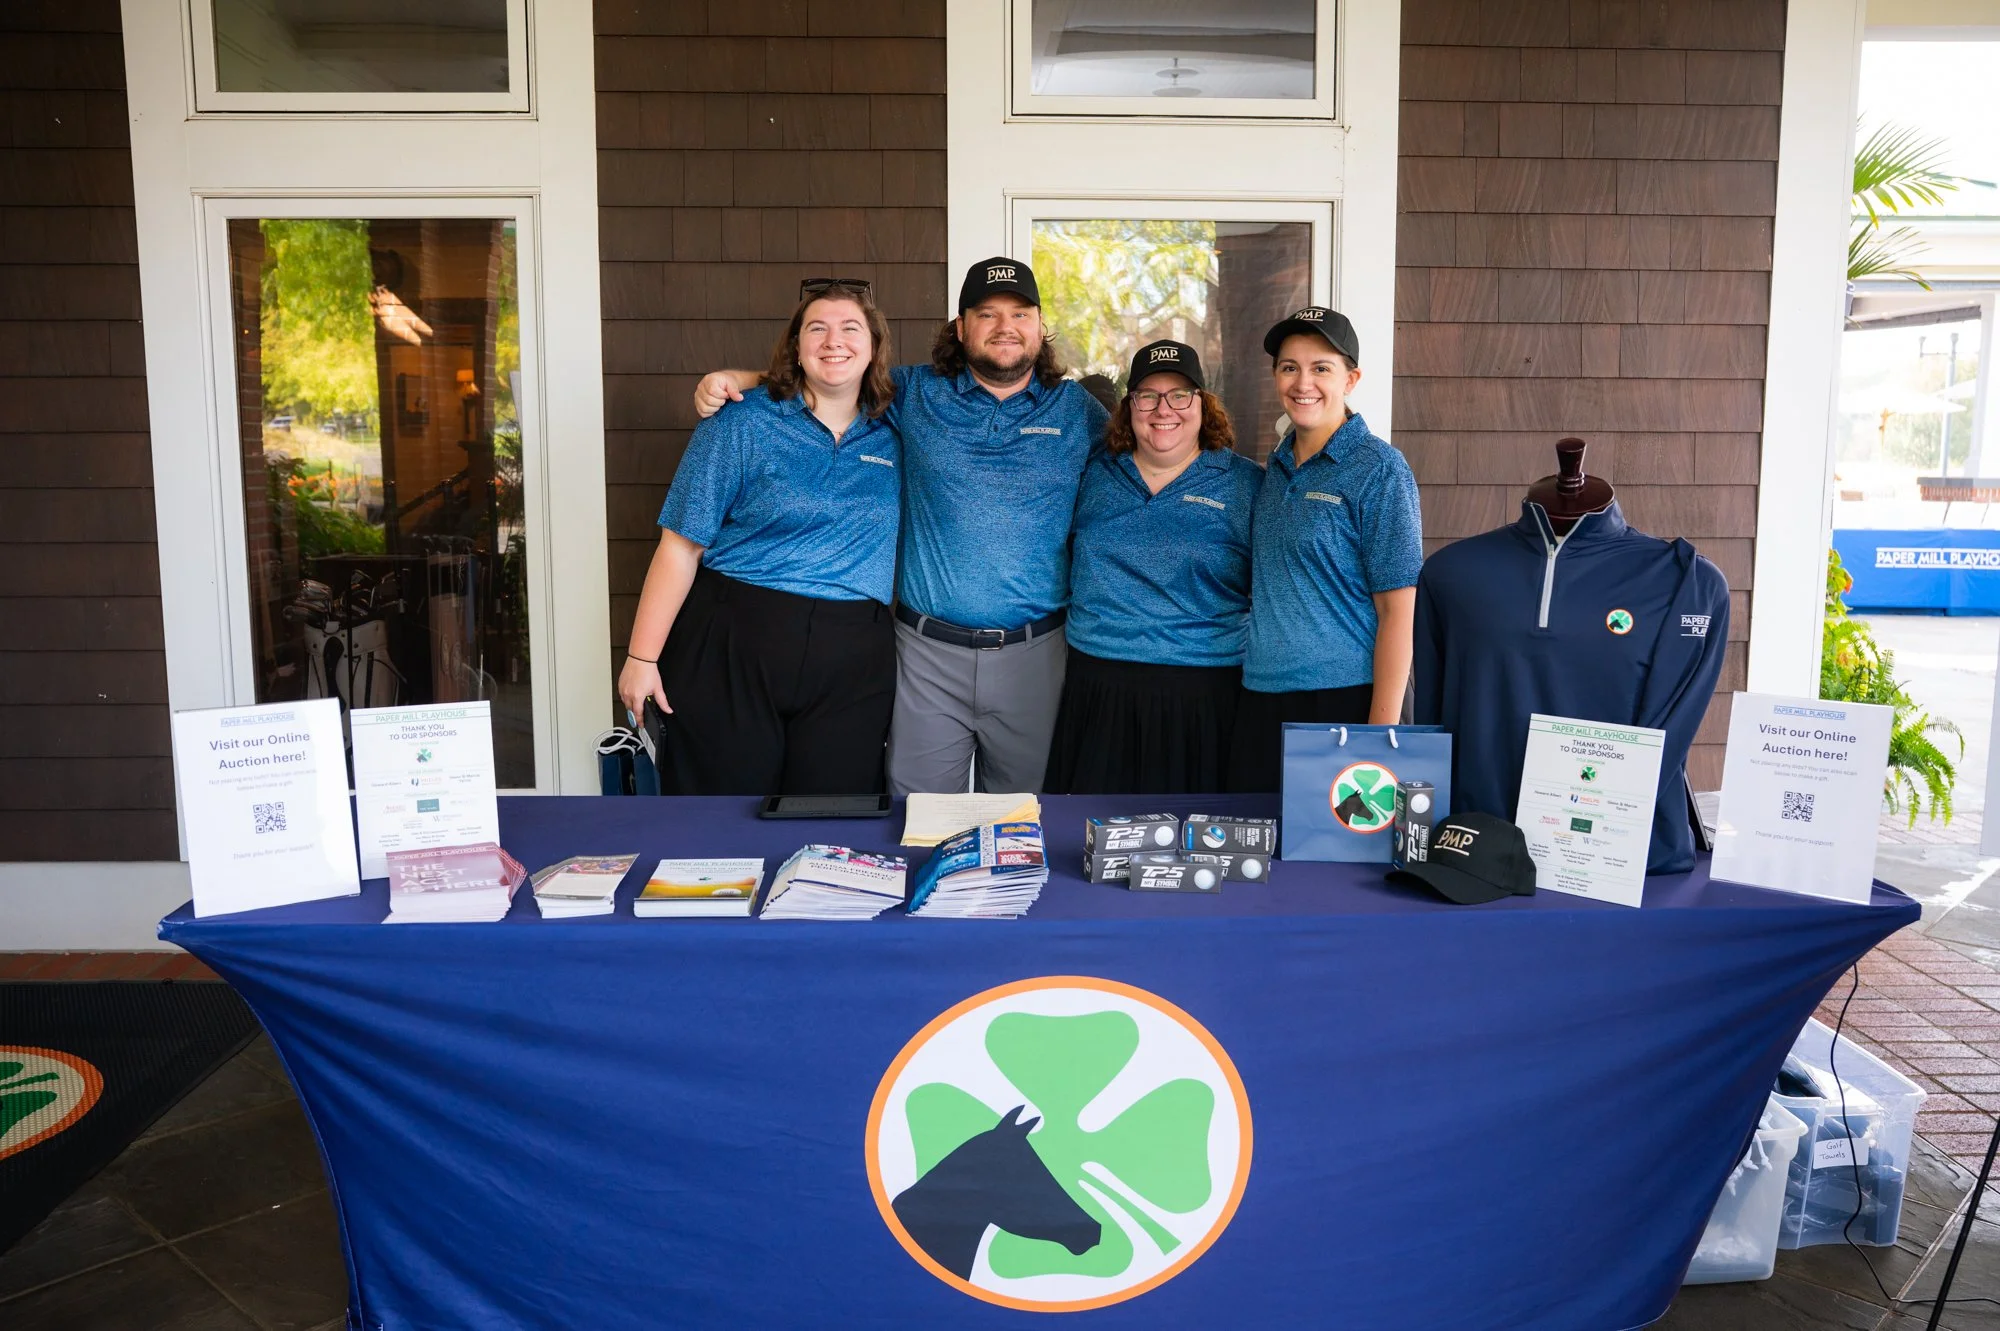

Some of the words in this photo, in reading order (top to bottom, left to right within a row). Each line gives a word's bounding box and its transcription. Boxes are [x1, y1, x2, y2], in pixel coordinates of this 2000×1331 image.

[987, 268, 1016, 281] PMP
[1295, 310, 1324, 319] PMP
[1150, 348, 1178, 360] PMP
[1876, 551, 1916, 564] PAPER
[1917, 551, 1948, 566] MILL
[1950, 552, 2000, 567] PLAYHO
[1681, 617, 1705, 626] PAPER
[375, 714, 400, 722] PAPER
[402, 712, 419, 722] MILL
[421, 709, 467, 720] PLAYHOUSE
[1774, 706, 1793, 715] PAPER
[1794, 708, 1807, 717] MILL
[1809, 710, 1846, 720] PLAYHOUSE
[401, 724, 426, 733] THANK
[428, 723, 445, 731] YOU
[1552, 723, 1574, 734] PAPER
[1575, 727, 1592, 736] MILL
[1594, 729, 1639, 743] PLAYHOUSE
[1760, 724, 1787, 735] Visit
[1790, 728, 1811, 738] our
[1814, 730, 1857, 743] Online
[419, 730, 457, 739] SPONSORS
[209, 738, 240, 751] Visit
[243, 738, 264, 748] our
[268, 732, 310, 745] Online
[1573, 740, 1596, 749] THANK
[1597, 743, 1614, 751] YOU
[1560, 745, 1570, 753] TO
[1571, 747, 1587, 755] OUR
[1588, 749, 1625, 761] SPONSORS
[1762, 743, 1811, 757] Auction
[1815, 748, 1848, 761] here!
[219, 756, 270, 770] Auction
[273, 750, 306, 763] here!
[1106, 826, 1147, 840] TP5
[1420, 826, 1429, 848] SYMBOL
[1120, 839, 1141, 848] SYMBOL
[1407, 821, 1419, 862] TP5
[1438, 830, 1473, 849] PMP
[394, 863, 445, 872] THE
[1103, 857, 1129, 870] TP
[400, 868, 469, 880] NEXT
[1116, 869, 1130, 878] SYM
[1141, 866, 1186, 878] TP5
[400, 876, 453, 887] ACT
[1155, 879, 1179, 888] SYMBOL
[1826, 1140, 1845, 1150] Golf
[1820, 1152, 1846, 1160] Towels
